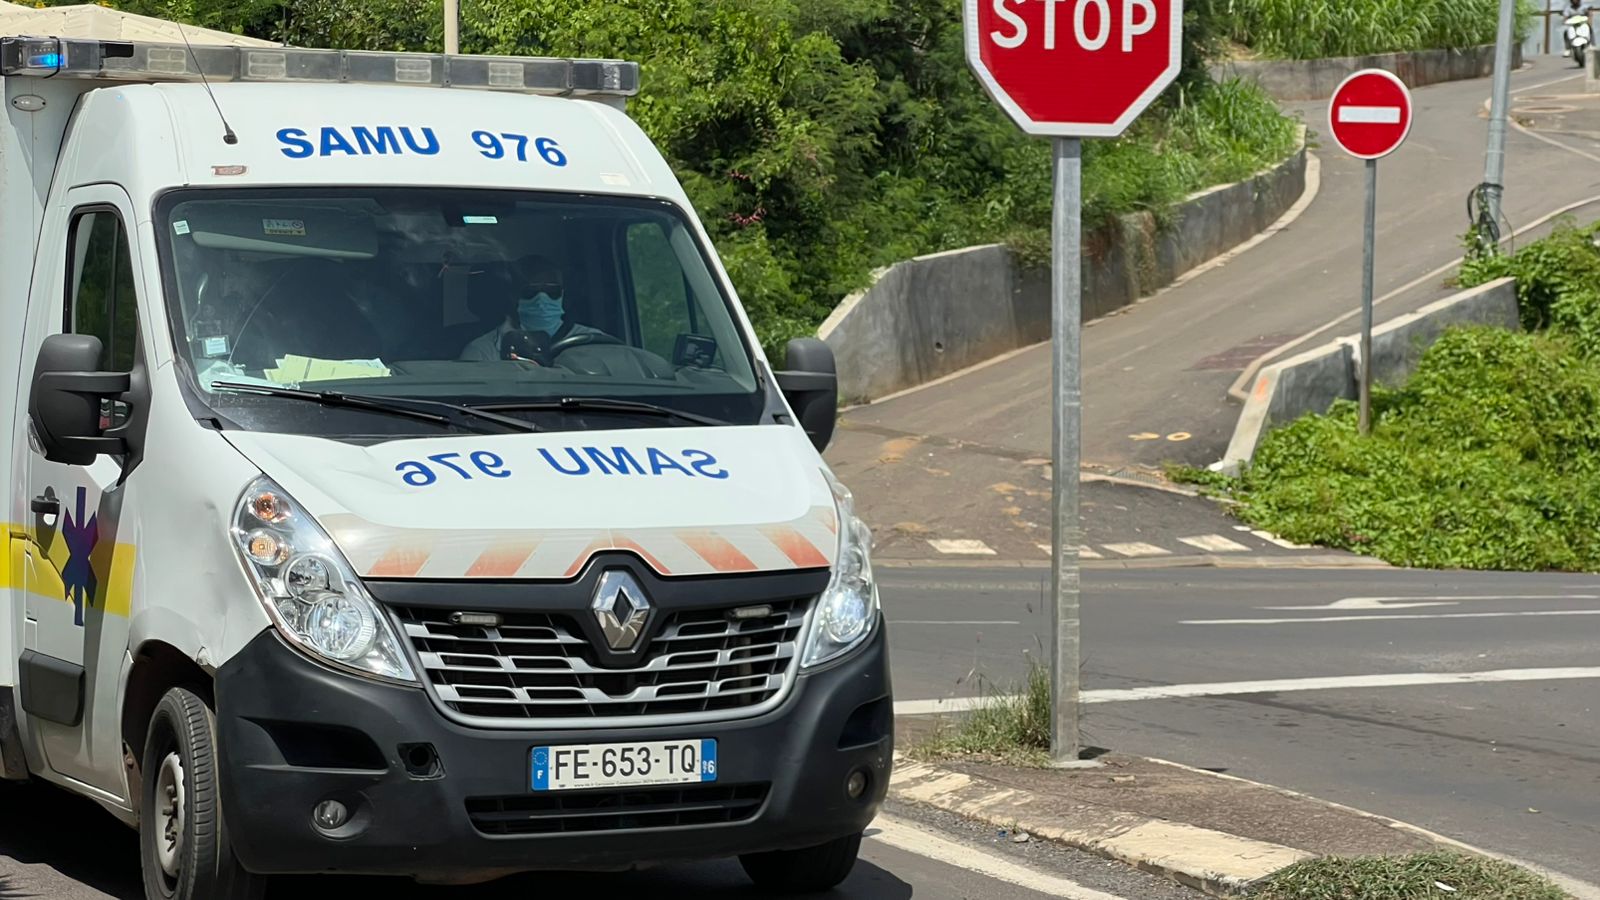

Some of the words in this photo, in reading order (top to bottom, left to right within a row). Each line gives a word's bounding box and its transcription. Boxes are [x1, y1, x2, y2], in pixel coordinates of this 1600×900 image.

[990, 0, 1157, 53] STOP
[277, 126, 441, 158] SAMU
[471, 130, 568, 168] 976
[537, 770, 544, 780] F
[555, 744, 696, 780] FE-653-TQ
